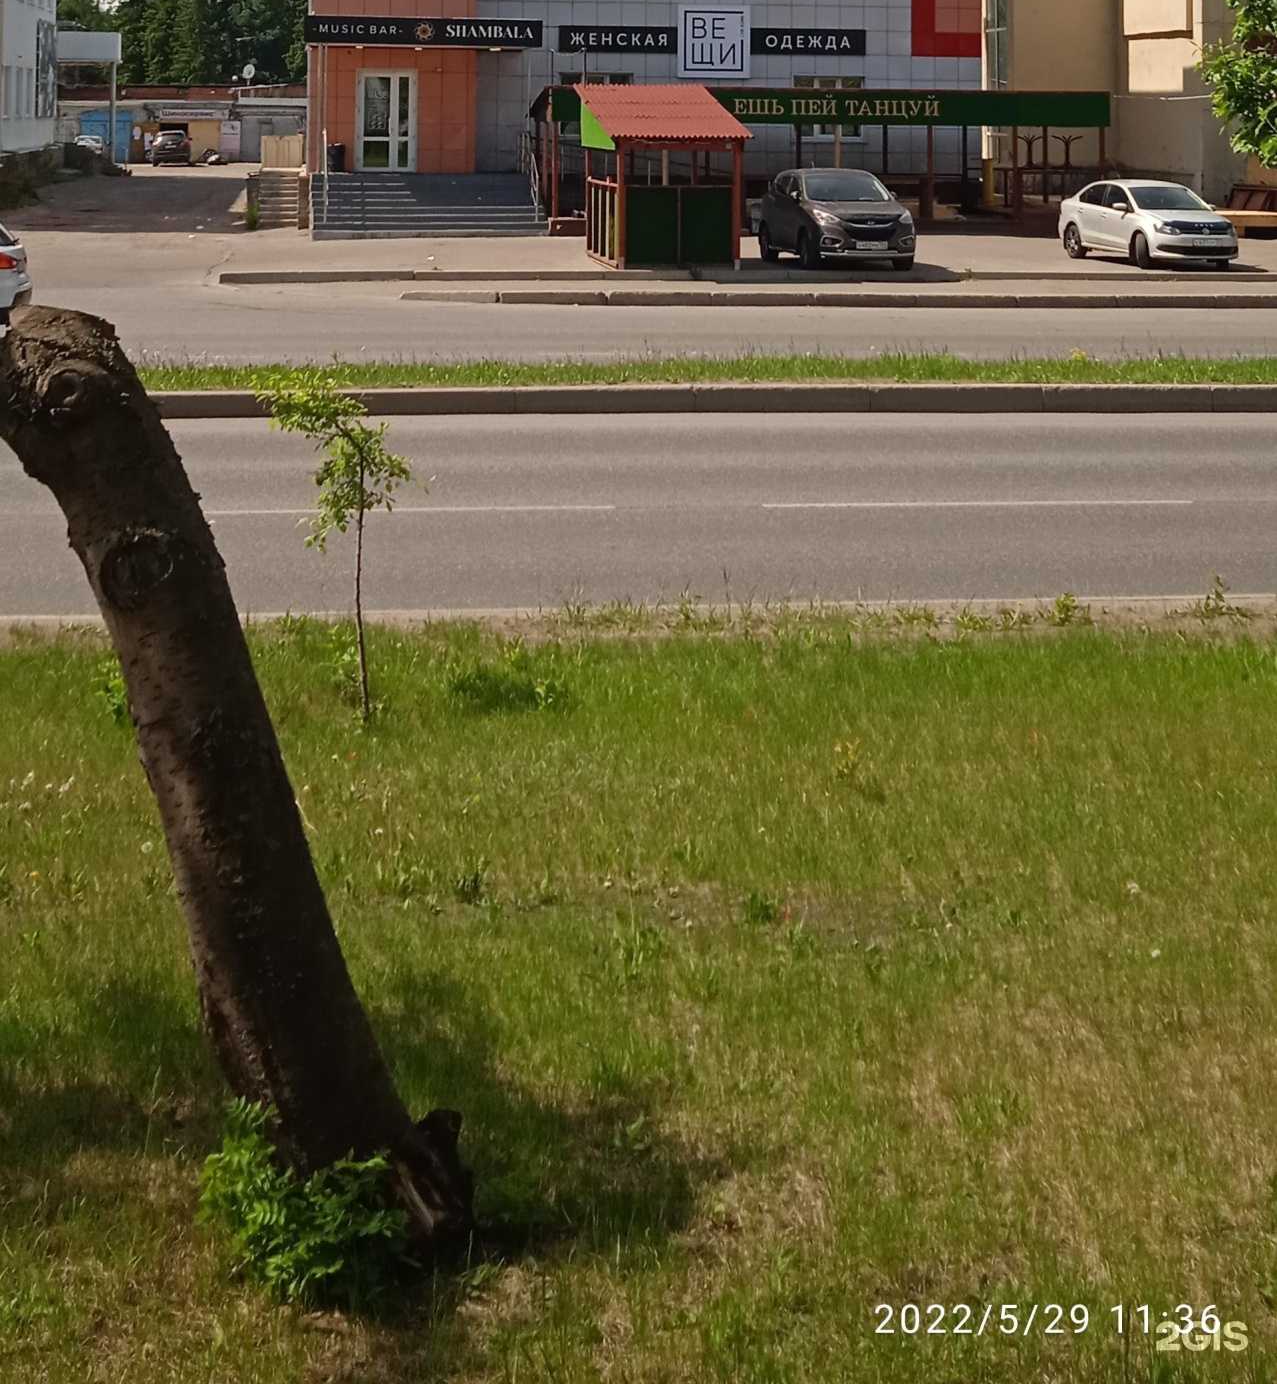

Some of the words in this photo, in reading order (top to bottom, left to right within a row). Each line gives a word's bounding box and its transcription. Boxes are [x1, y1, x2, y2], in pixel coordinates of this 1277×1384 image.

[445, 25, 534, 39] SHAMBALA
[570, 31, 669, 47] ЖЕНСКАЯ
[765, 34, 851, 50] ОДЕЖДА
[733, 98, 785, 115] ЕШЬ
[791, 94, 837, 116] ПЕЙ
[844, 95, 940, 119] ТАНЦУЙ
